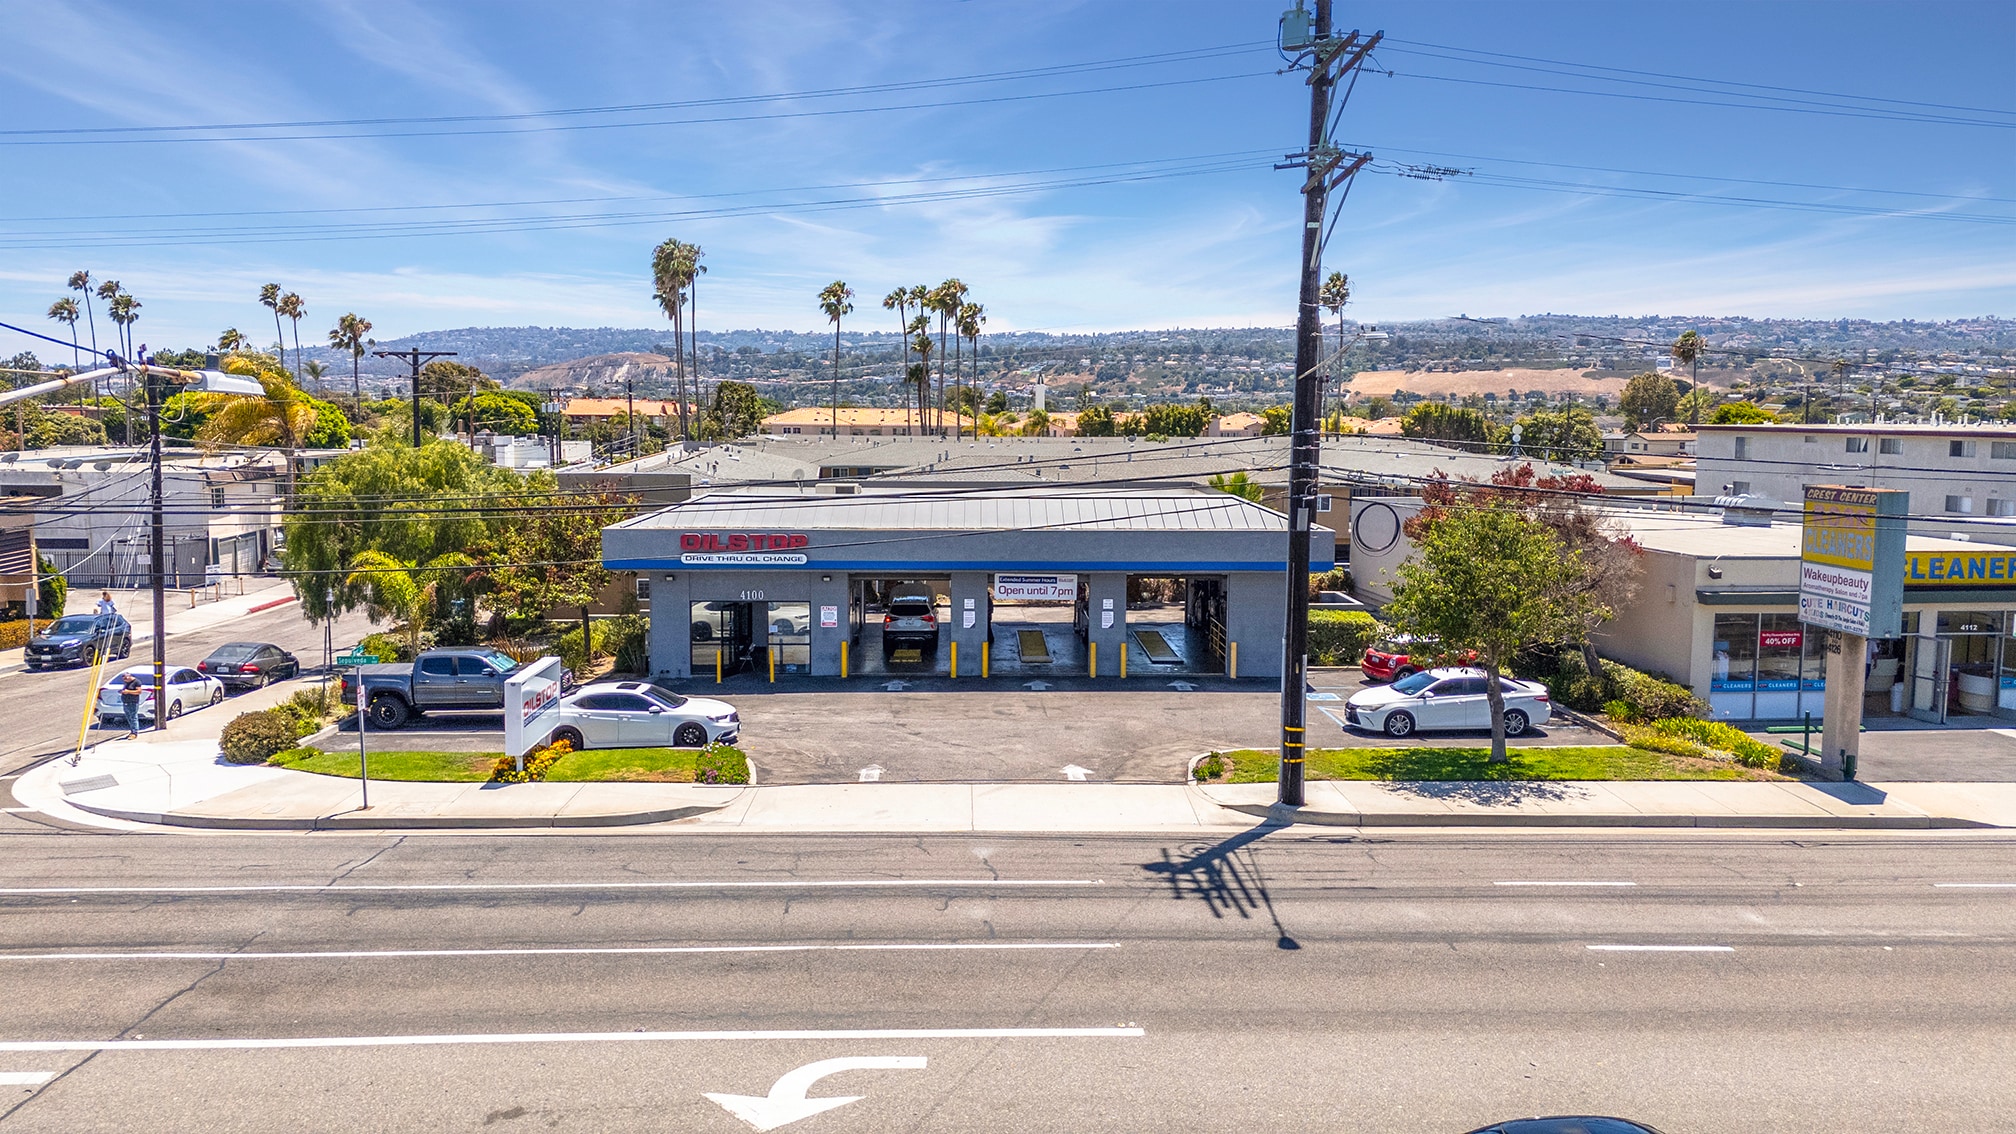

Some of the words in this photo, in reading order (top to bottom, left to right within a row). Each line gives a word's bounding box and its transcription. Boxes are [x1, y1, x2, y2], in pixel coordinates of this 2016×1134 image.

[1807, 488, 1837, 500] CREST
[1839, 491, 1877, 505] CENTER
[680, 533, 808, 551] OILSTOP
[1805, 527, 1873, 561] CLEANERS
[1803, 567, 1869, 592] Wakeupbeauty
[1803, 582, 1834, 594] Aromatherapy
[740, 590, 764, 600] 4100
[998, 585, 1024, 596] Open
[1027, 586, 1048, 595] until
[1051, 586, 1073, 597] 7pm
[1801, 597, 1823, 609] CUTE
[1827, 599, 1870, 622] HAIRCUTS
[1782, 637, 1797, 645] OFF
[523, 681, 558, 717] OILSTOP
